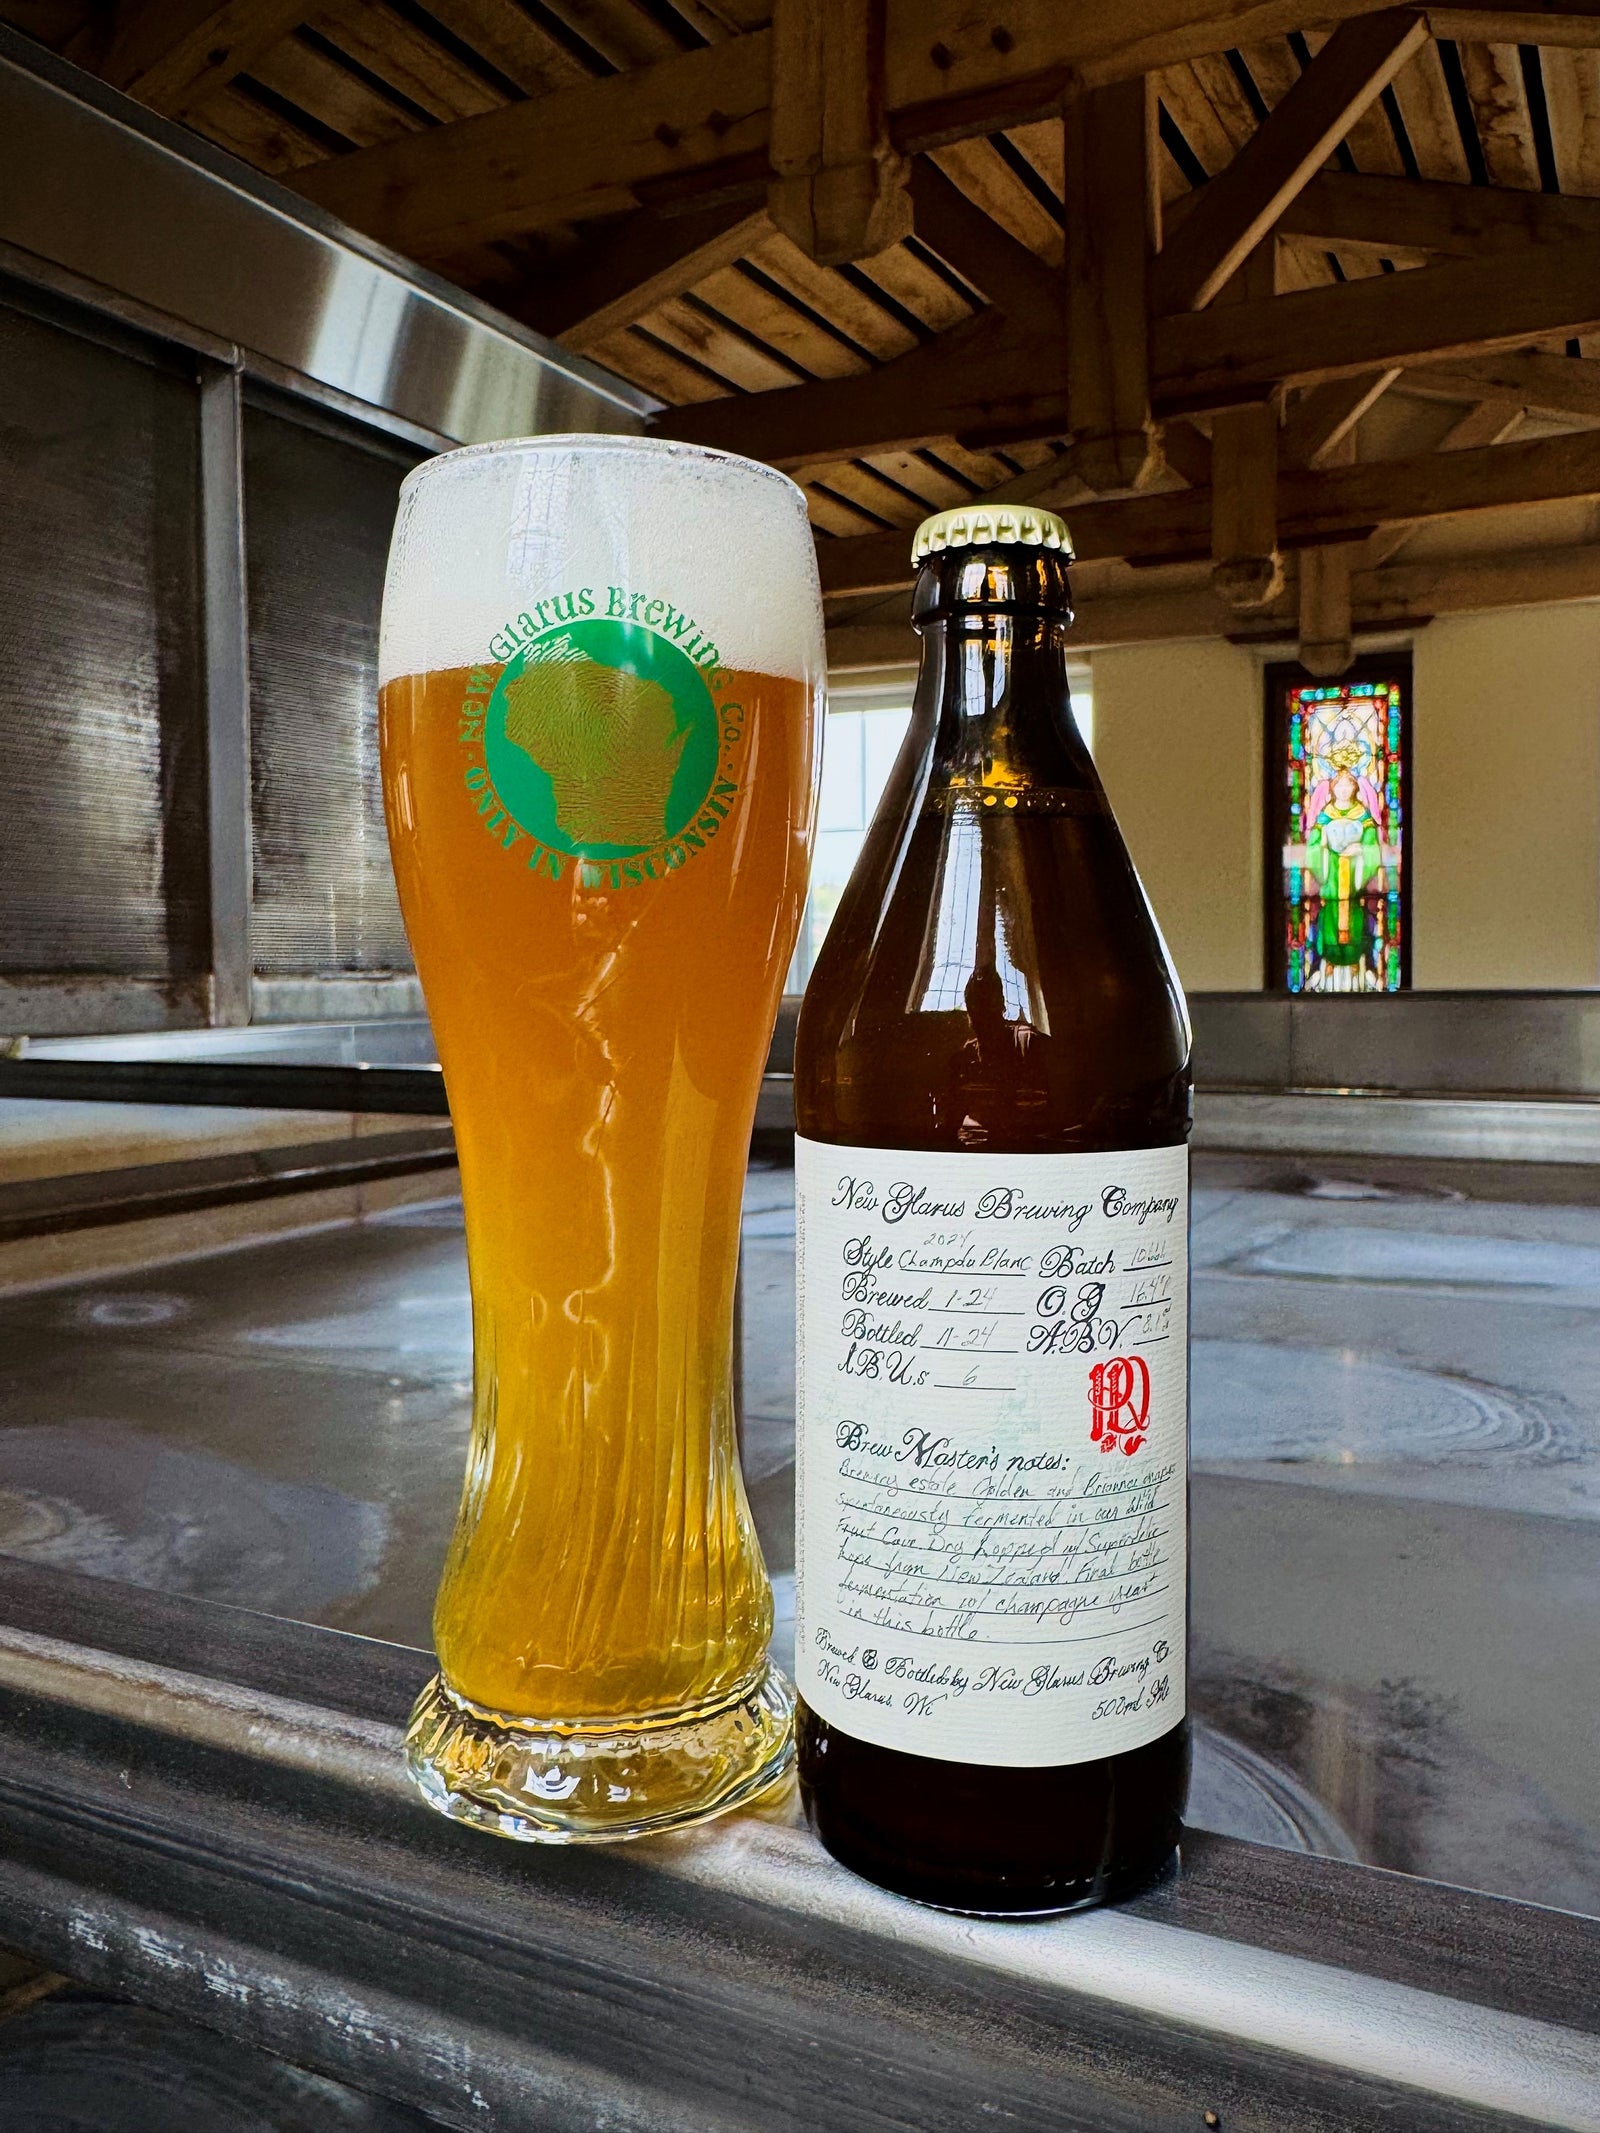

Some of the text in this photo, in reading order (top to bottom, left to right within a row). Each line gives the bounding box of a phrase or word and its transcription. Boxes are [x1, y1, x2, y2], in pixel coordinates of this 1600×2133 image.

[488, 587, 595, 662] Glarus
[604, 586, 735, 691] Brewing
[464, 766, 739, 890] ONLY IN WISCONSIN
[831, 1175, 1179, 1233] New Glarus Brewing Company
[842, 1235, 894, 1279] Style
[1039, 1244, 1116, 1279] Batch
[841, 1270, 934, 1311] Brewed
[841, 1307, 924, 1348] Bottled
[962, 1364, 980, 1387] 6
[835, 1419, 1071, 1472] Brew Master's notes:
[816, 1658, 841, 1688] New
[972, 1665, 1025, 1693] New
[1022, 1664, 1086, 1697] Glarus
